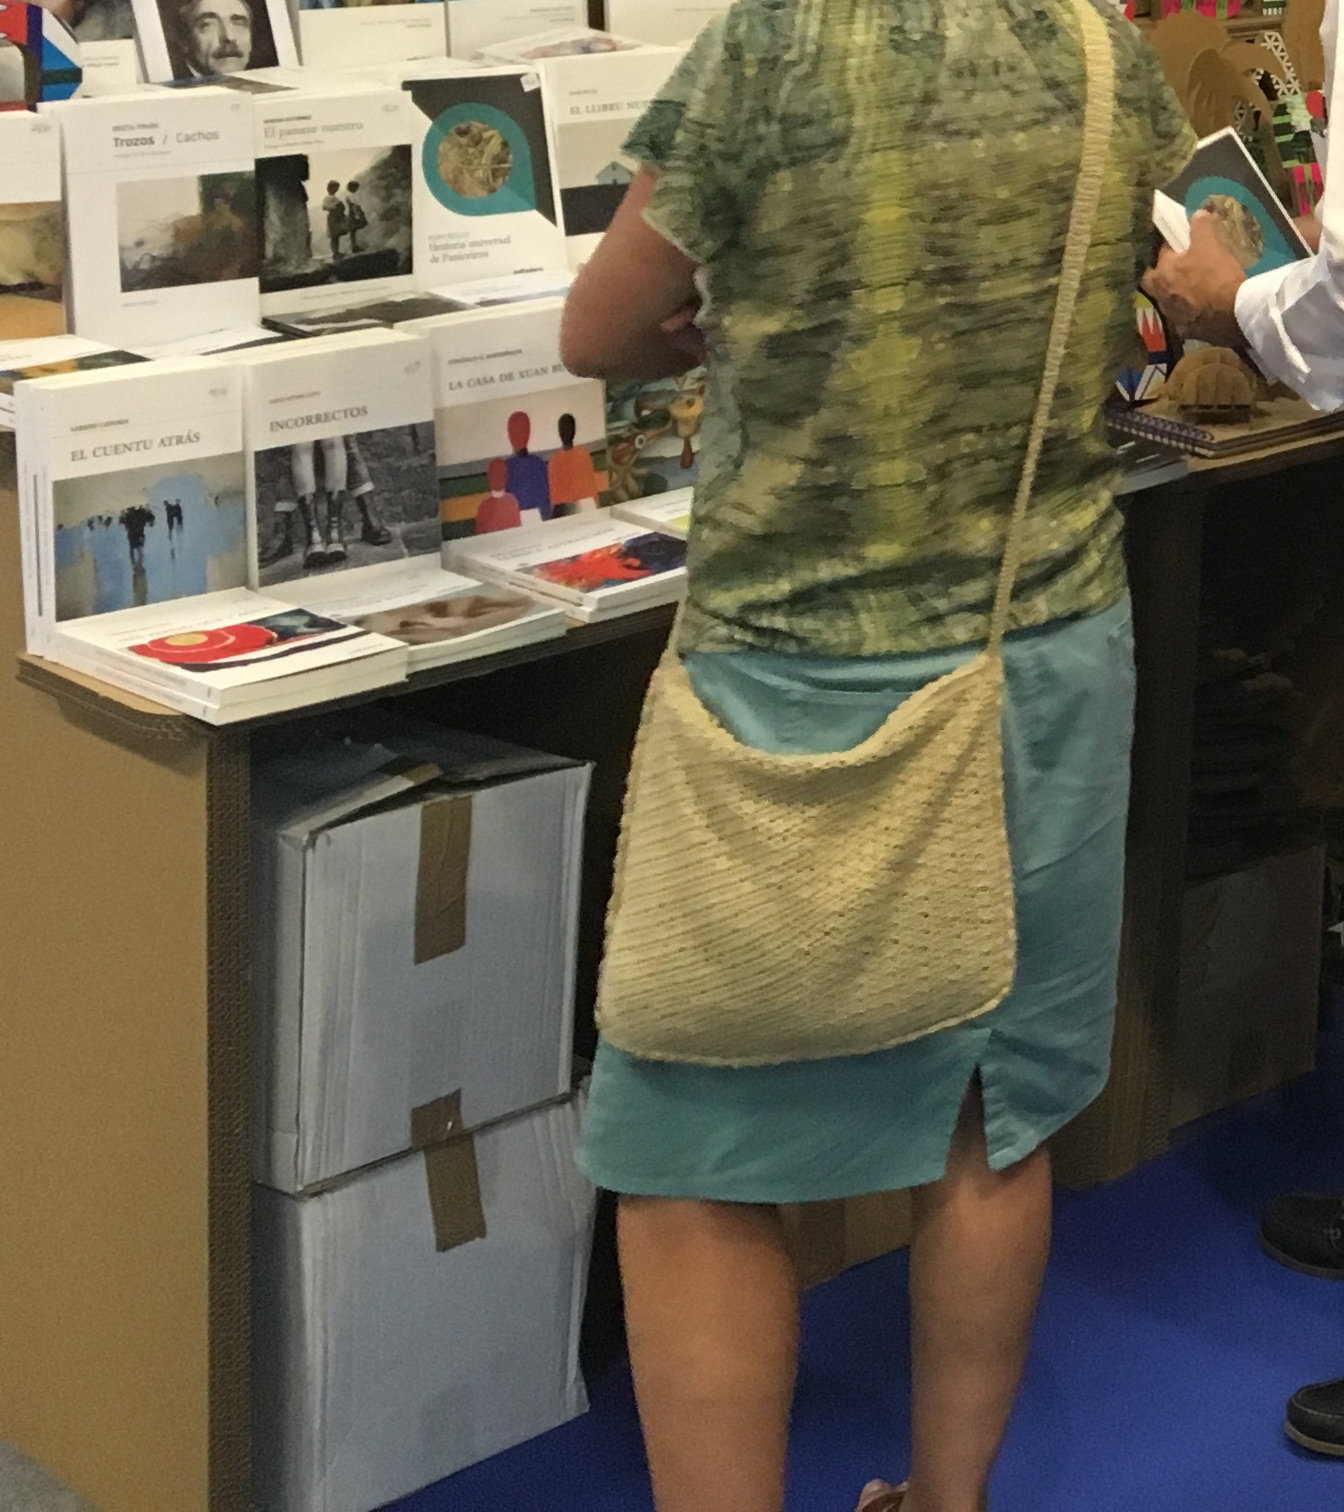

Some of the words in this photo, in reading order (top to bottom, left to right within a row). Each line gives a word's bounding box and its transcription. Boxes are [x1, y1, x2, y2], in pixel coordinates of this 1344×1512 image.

[112, 134, 156, 149] Trozos
[175, 128, 220, 145] Cachos
[448, 380, 464, 392] LA
[466, 374, 497, 389] CASA
[268, 405, 369, 434] INCORRECTOS
[69, 447, 89, 462] EL
[91, 437, 154, 459] CUENTU
[157, 429, 201, 449] ATRÁS
